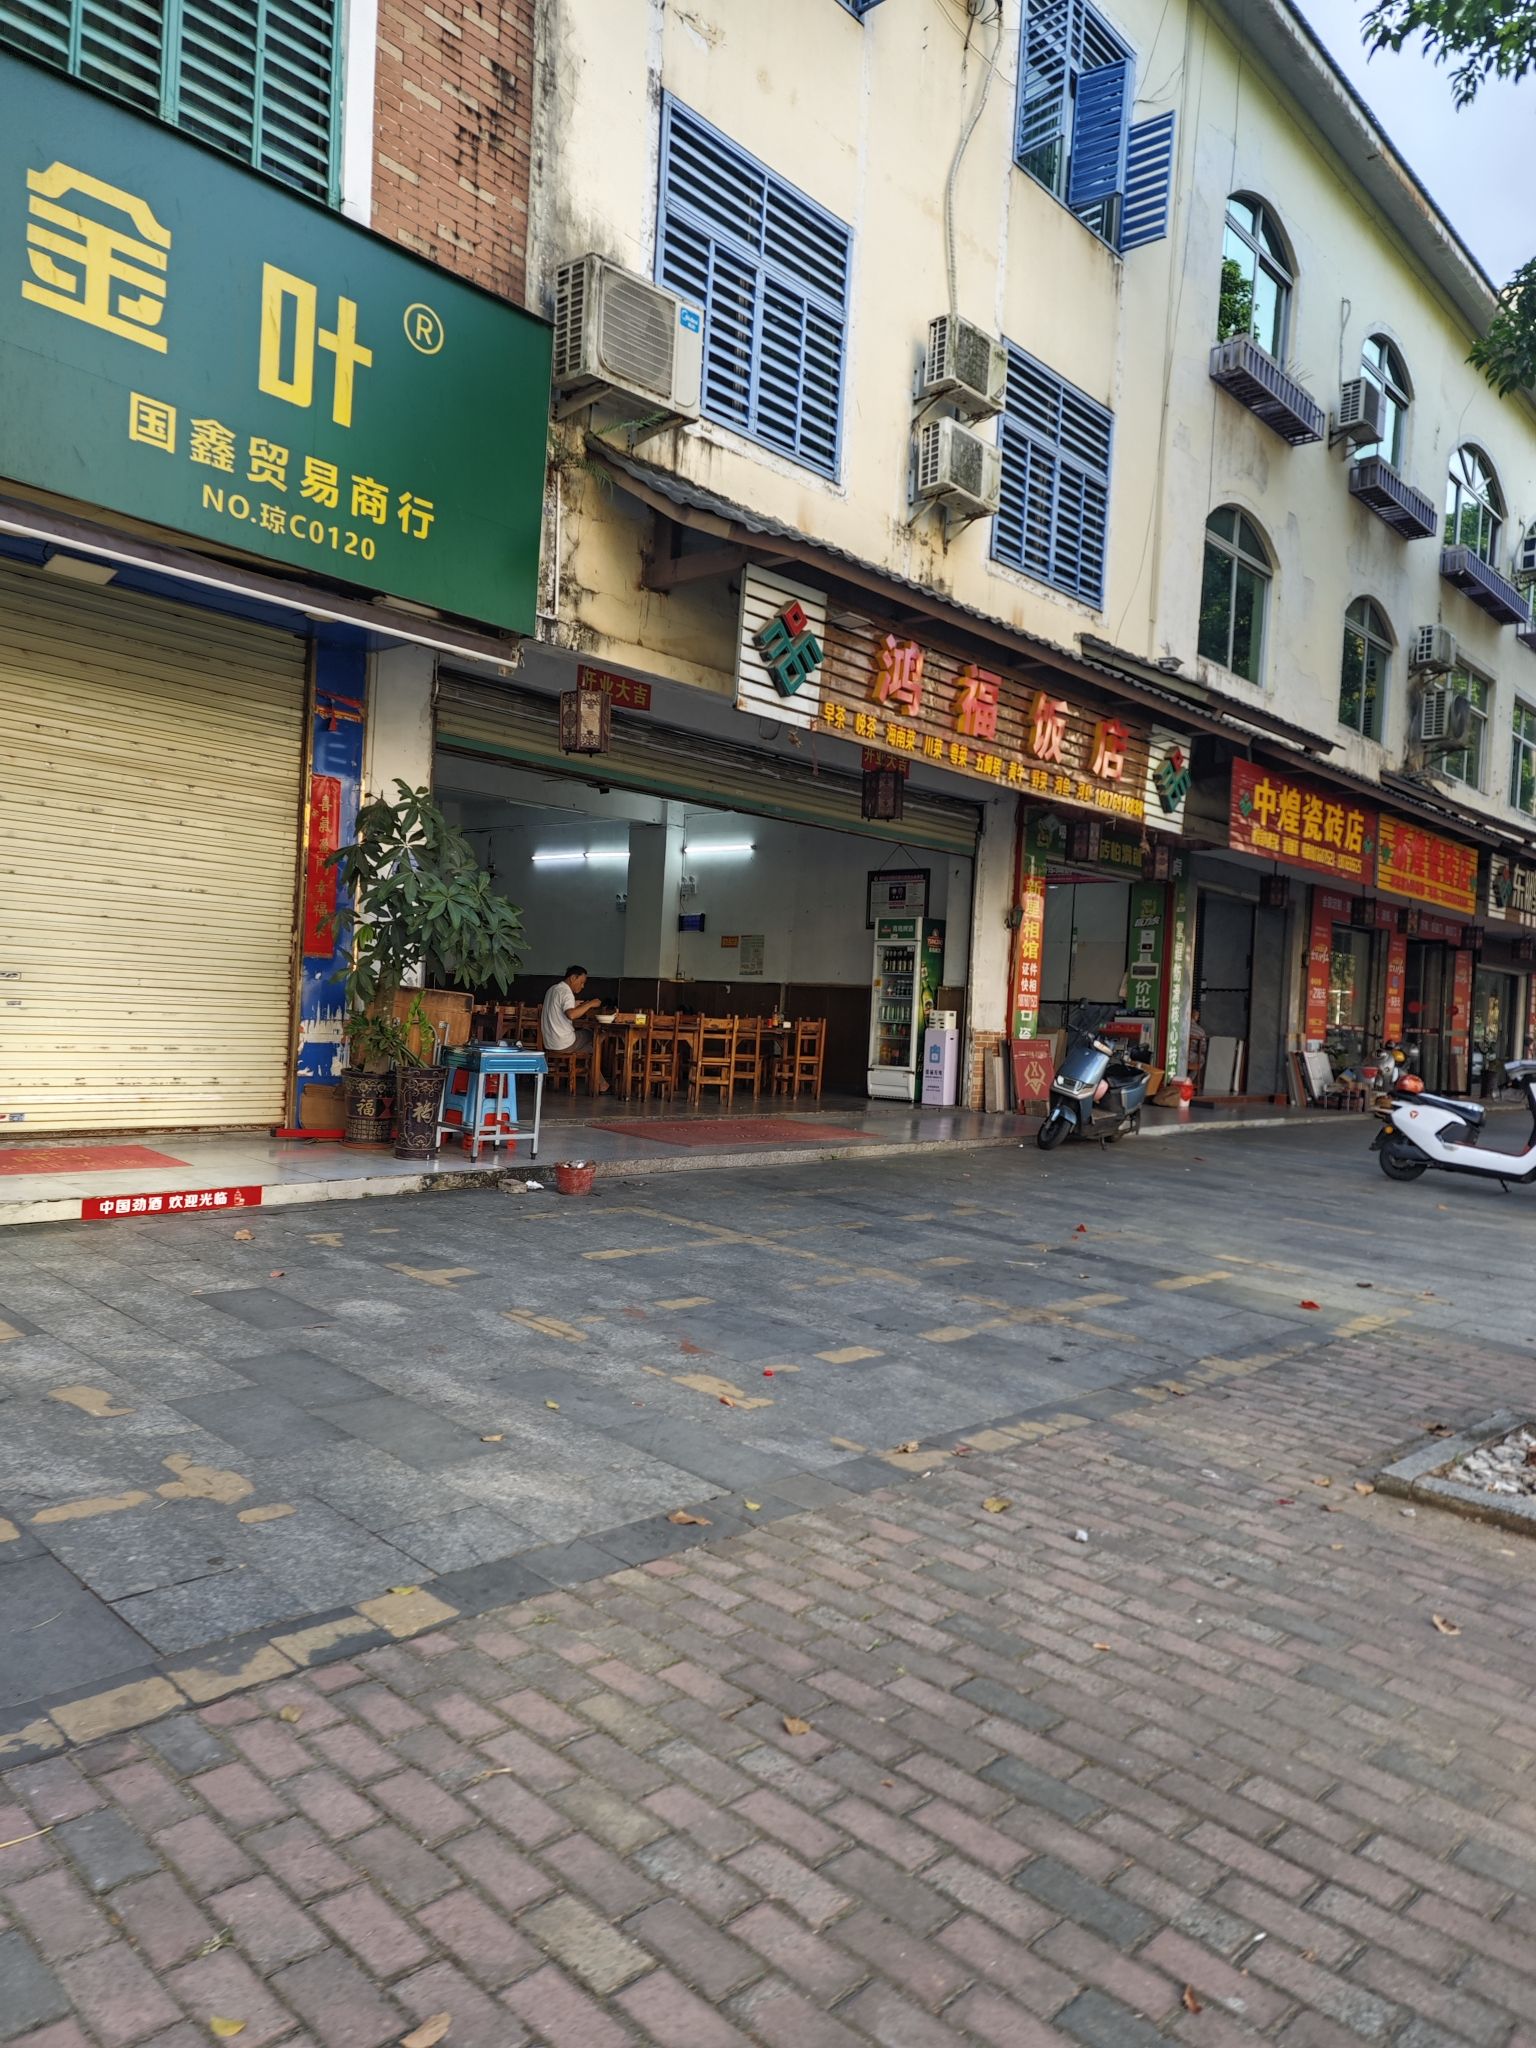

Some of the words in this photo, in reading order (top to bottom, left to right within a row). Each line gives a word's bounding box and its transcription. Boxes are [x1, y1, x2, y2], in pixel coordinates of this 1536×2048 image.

[21, 161, 372, 428] 金叶
[129, 392, 436, 540] 国鑫贸易商行
[202, 485, 376, 561] NO.琼C0120
[581, 667, 648, 705] 开业大吉
[872, 632, 1130, 782] 鸿福饭店
[824, 702, 847, 729] 早茶
[855, 712, 878, 740] 晚茶
[885, 722, 917, 752] 海南菜
[923, 735, 944, 760] 川菜
[1253, 777, 1365, 854] 中煌瓷砖店
[1022, 878, 1043, 960] 新星相馆
[1020, 977, 1037, 992] 快相
[1021, 962, 1038, 976] 证件
[356, 1098, 375, 1117] 福
[99, 1195, 163, 1215] 中国劲酒
[168, 1190, 228, 1210] 欢迎光临
